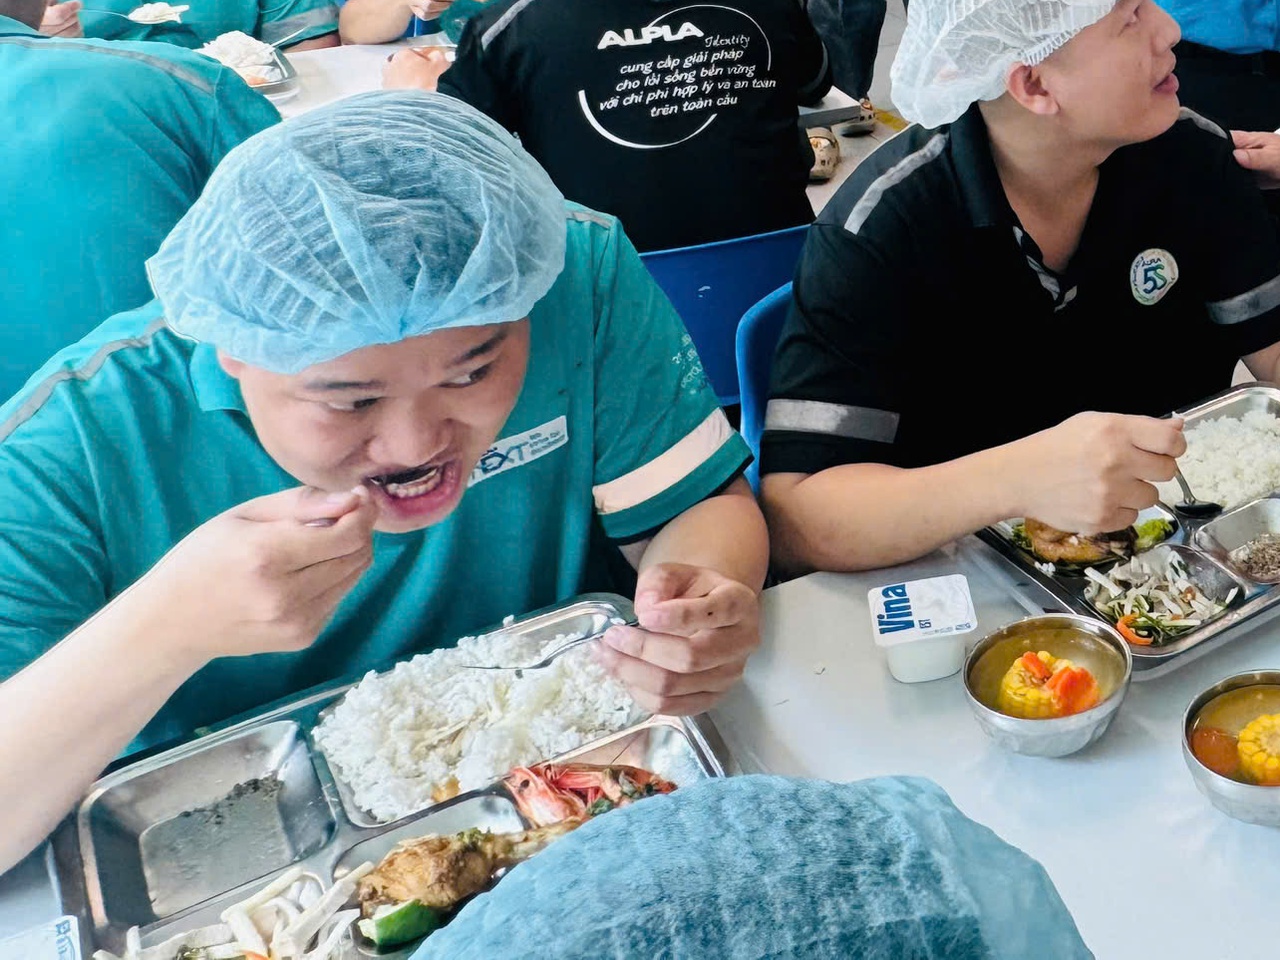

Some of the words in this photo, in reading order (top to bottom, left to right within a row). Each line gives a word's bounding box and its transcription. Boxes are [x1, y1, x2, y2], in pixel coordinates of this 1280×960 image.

[597, 22, 704, 50] ALPLA
[620, 63, 652, 76] cung
[711, 48, 744, 65] pháp
[616, 78, 640, 92] cho
[664, 67, 696, 86] sống
[623, 90, 644, 106] chi
[734, 79, 748, 89] an
[650, 104, 678, 118] trên
[682, 98, 712, 112] toàn
[877, 583, 915, 635] Vina
